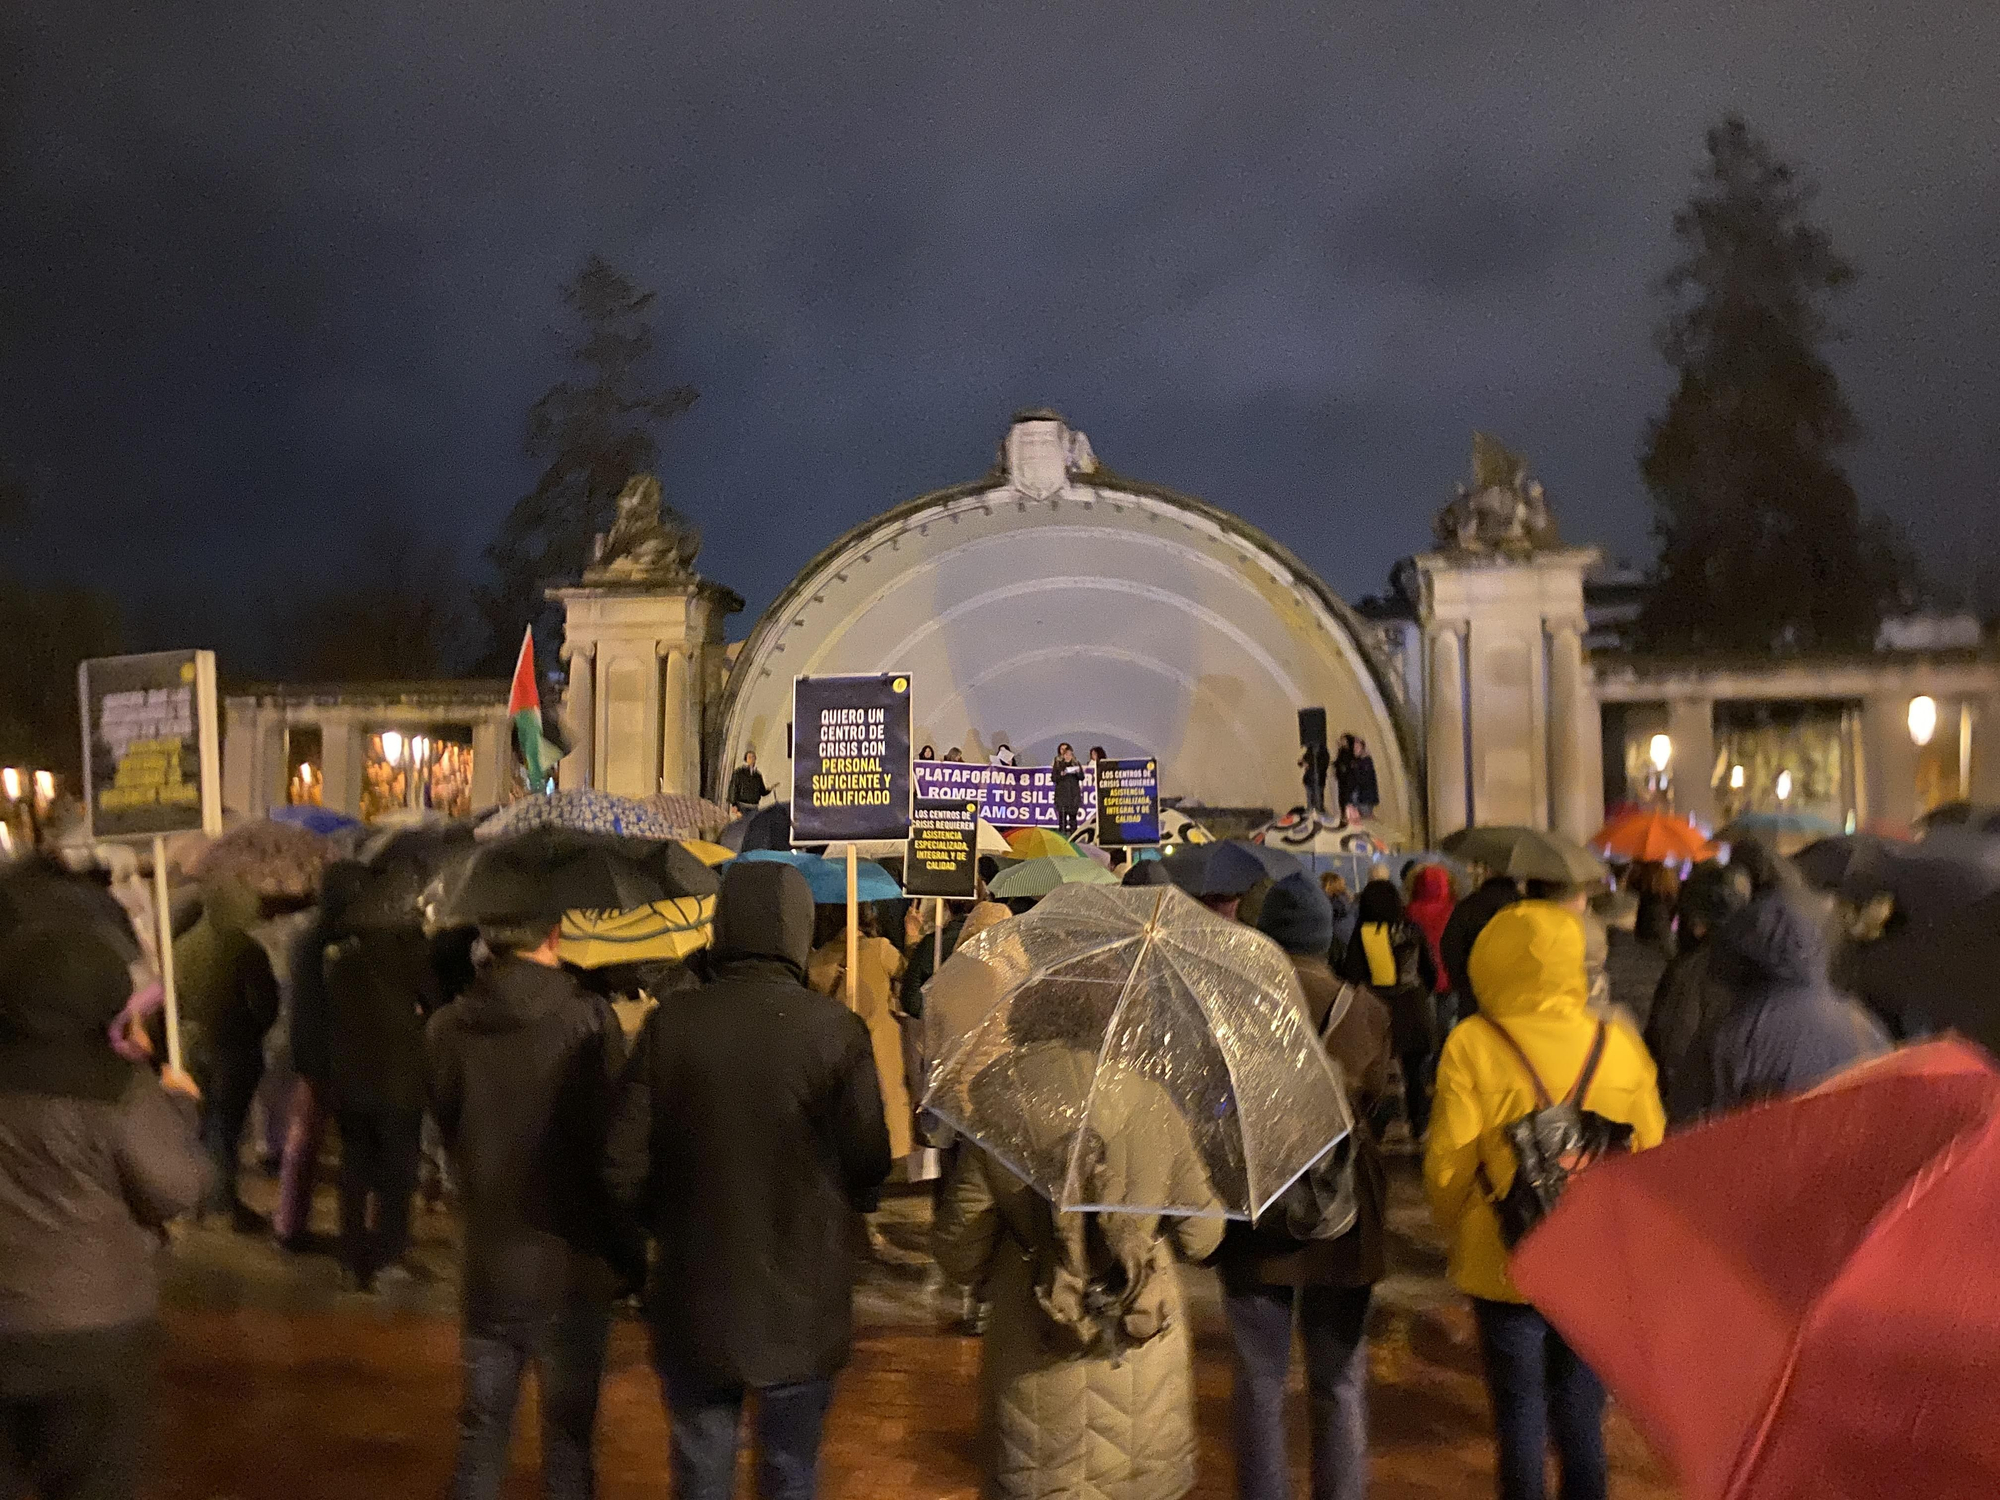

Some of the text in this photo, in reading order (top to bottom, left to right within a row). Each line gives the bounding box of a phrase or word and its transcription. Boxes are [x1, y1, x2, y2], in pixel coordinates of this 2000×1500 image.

[821, 708, 884, 725] QUIERO UN
[820, 725, 885, 741] CENTRO DE
[819, 741, 886, 757] CRISIS CON
[822, 757, 882, 773] PERSONAL
[812, 773, 892, 790] SUFICIENTE Y
[915, 767, 1054, 786] PLATAFORMA 8 DE
[1102, 771, 1113, 779] LOS
[812, 790, 890, 807] CUALIFICADO
[928, 786, 988, 802] ROMPE
[992, 789, 1016, 803] TU
[915, 810, 971, 820] LOS CENTROS DE
[980, 805, 1030, 820] AMOS
[1035, 807, 1057, 820] LA
[935, 821, 975, 831] REQUIEREN
[922, 830, 963, 840] ASISTENCIA
[916, 850, 967, 861] INTEGRAL Y DE
[926, 861, 957, 870] CALIDAD
